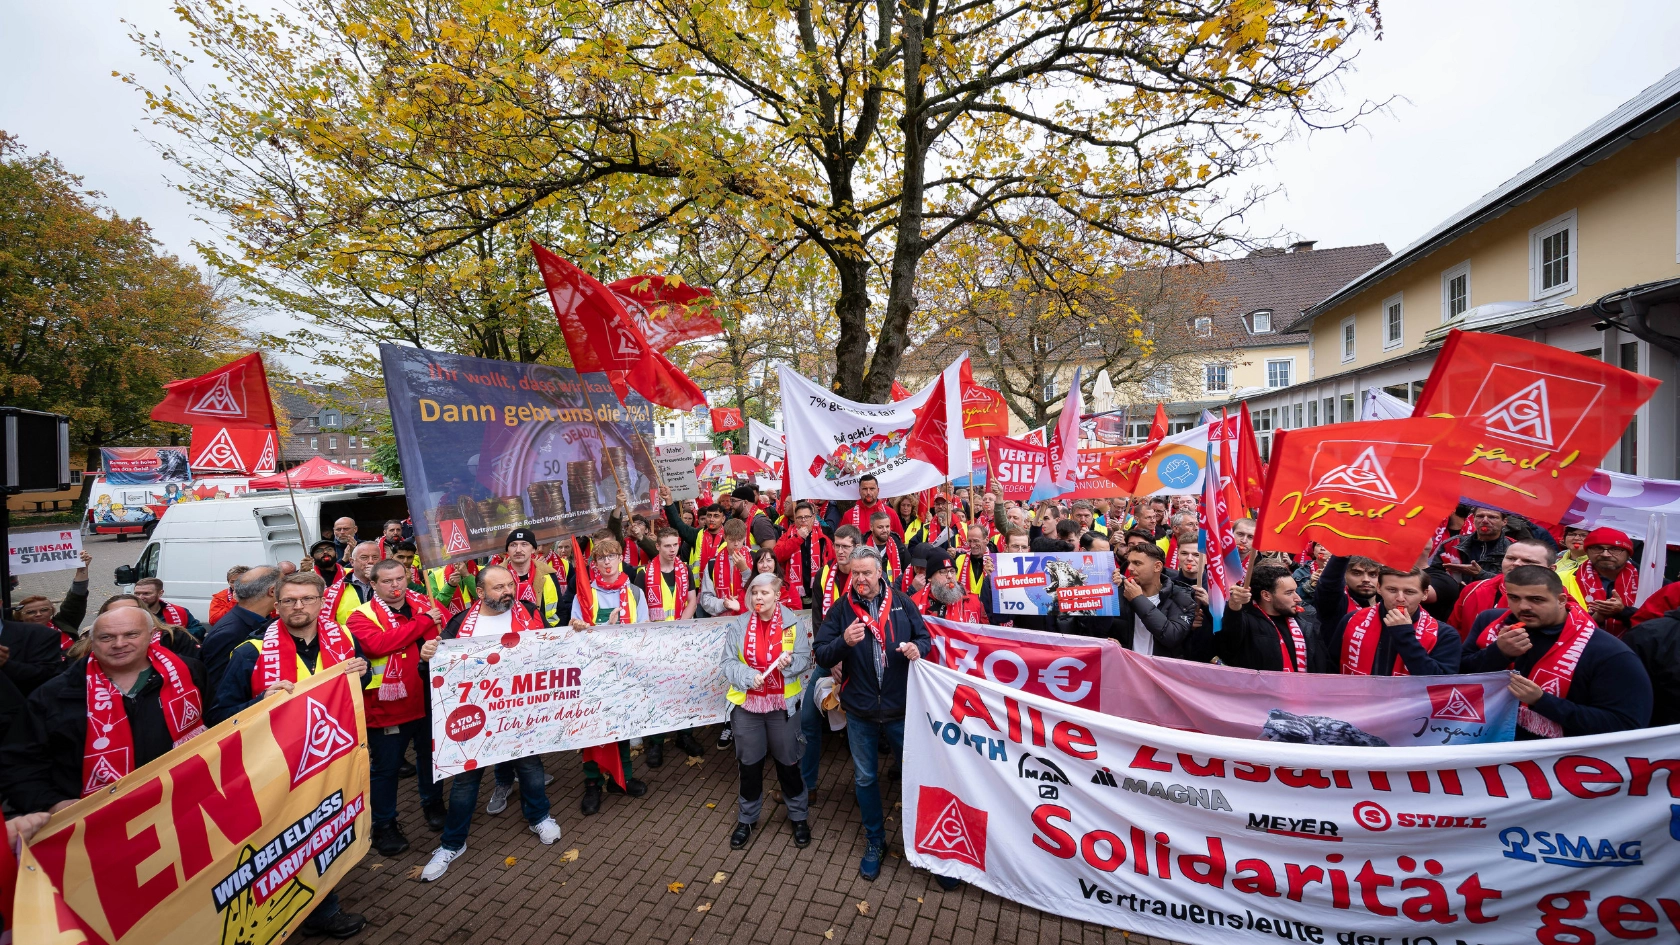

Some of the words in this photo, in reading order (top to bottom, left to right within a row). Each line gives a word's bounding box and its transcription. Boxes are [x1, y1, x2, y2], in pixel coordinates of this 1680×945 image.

[428, 362, 458, 381] Ihr
[462, 371, 517, 391] wollt,
[519, 375, 556, 392] dass
[419, 398, 496, 422] Dann
[504, 402, 555, 427] gebt
[556, 408, 594, 422] uns
[597, 403, 621, 422] die
[809, 395, 827, 408] 7%
[878, 408, 896, 417] fair
[543, 459, 560, 476] 50
[470, 520, 523, 536] Vertrauensleute
[524, 516, 545, 527] Robert
[9, 543, 73, 555] EMEINSAM
[21, 550, 77, 564] STARK!
[996, 578, 1010, 587] Wir
[1011, 576, 1045, 586] fordern:
[1058, 589, 1072, 598] 170
[1073, 588, 1091, 597] Euro
[1092, 586, 1111, 595] mehr
[1003, 601, 1025, 611] 170
[1060, 601, 1073, 610] für
[1073, 600, 1102, 609] Azubis!
[458, 682, 473, 704] 7
[479, 678, 503, 699] %
[511, 667, 582, 695] MEHR
[488, 695, 528, 711] NÖTIG
[528, 693, 551, 705] UND
[553, 689, 580, 701] FAIR!
[451, 727, 462, 736] für
[461, 720, 482, 732] Azubis
[456, 715, 473, 727] 170
[496, 716, 524, 734] Ich
[526, 713, 551, 727] bin
[554, 701, 602, 721] dabei!
[950, 684, 1098, 761] Alle
[1025, 769, 1070, 785] MAN
[1123, 777, 1232, 812] MAGNA
[1248, 812, 1339, 836] MEYER
[1397, 812, 1487, 829] STOLL
[214, 862, 254, 906] WIR
[254, 838, 283, 873] BEI
[283, 792, 342, 849] ELMESS
[256, 796, 362, 897] TARIFVERTRAG
[318, 826, 353, 874] JETZT
[1533, 831, 1642, 861] SMAG
[1031, 804, 1502, 924] Solidarität
[1078, 878, 1325, 945] Vertrauensleute
